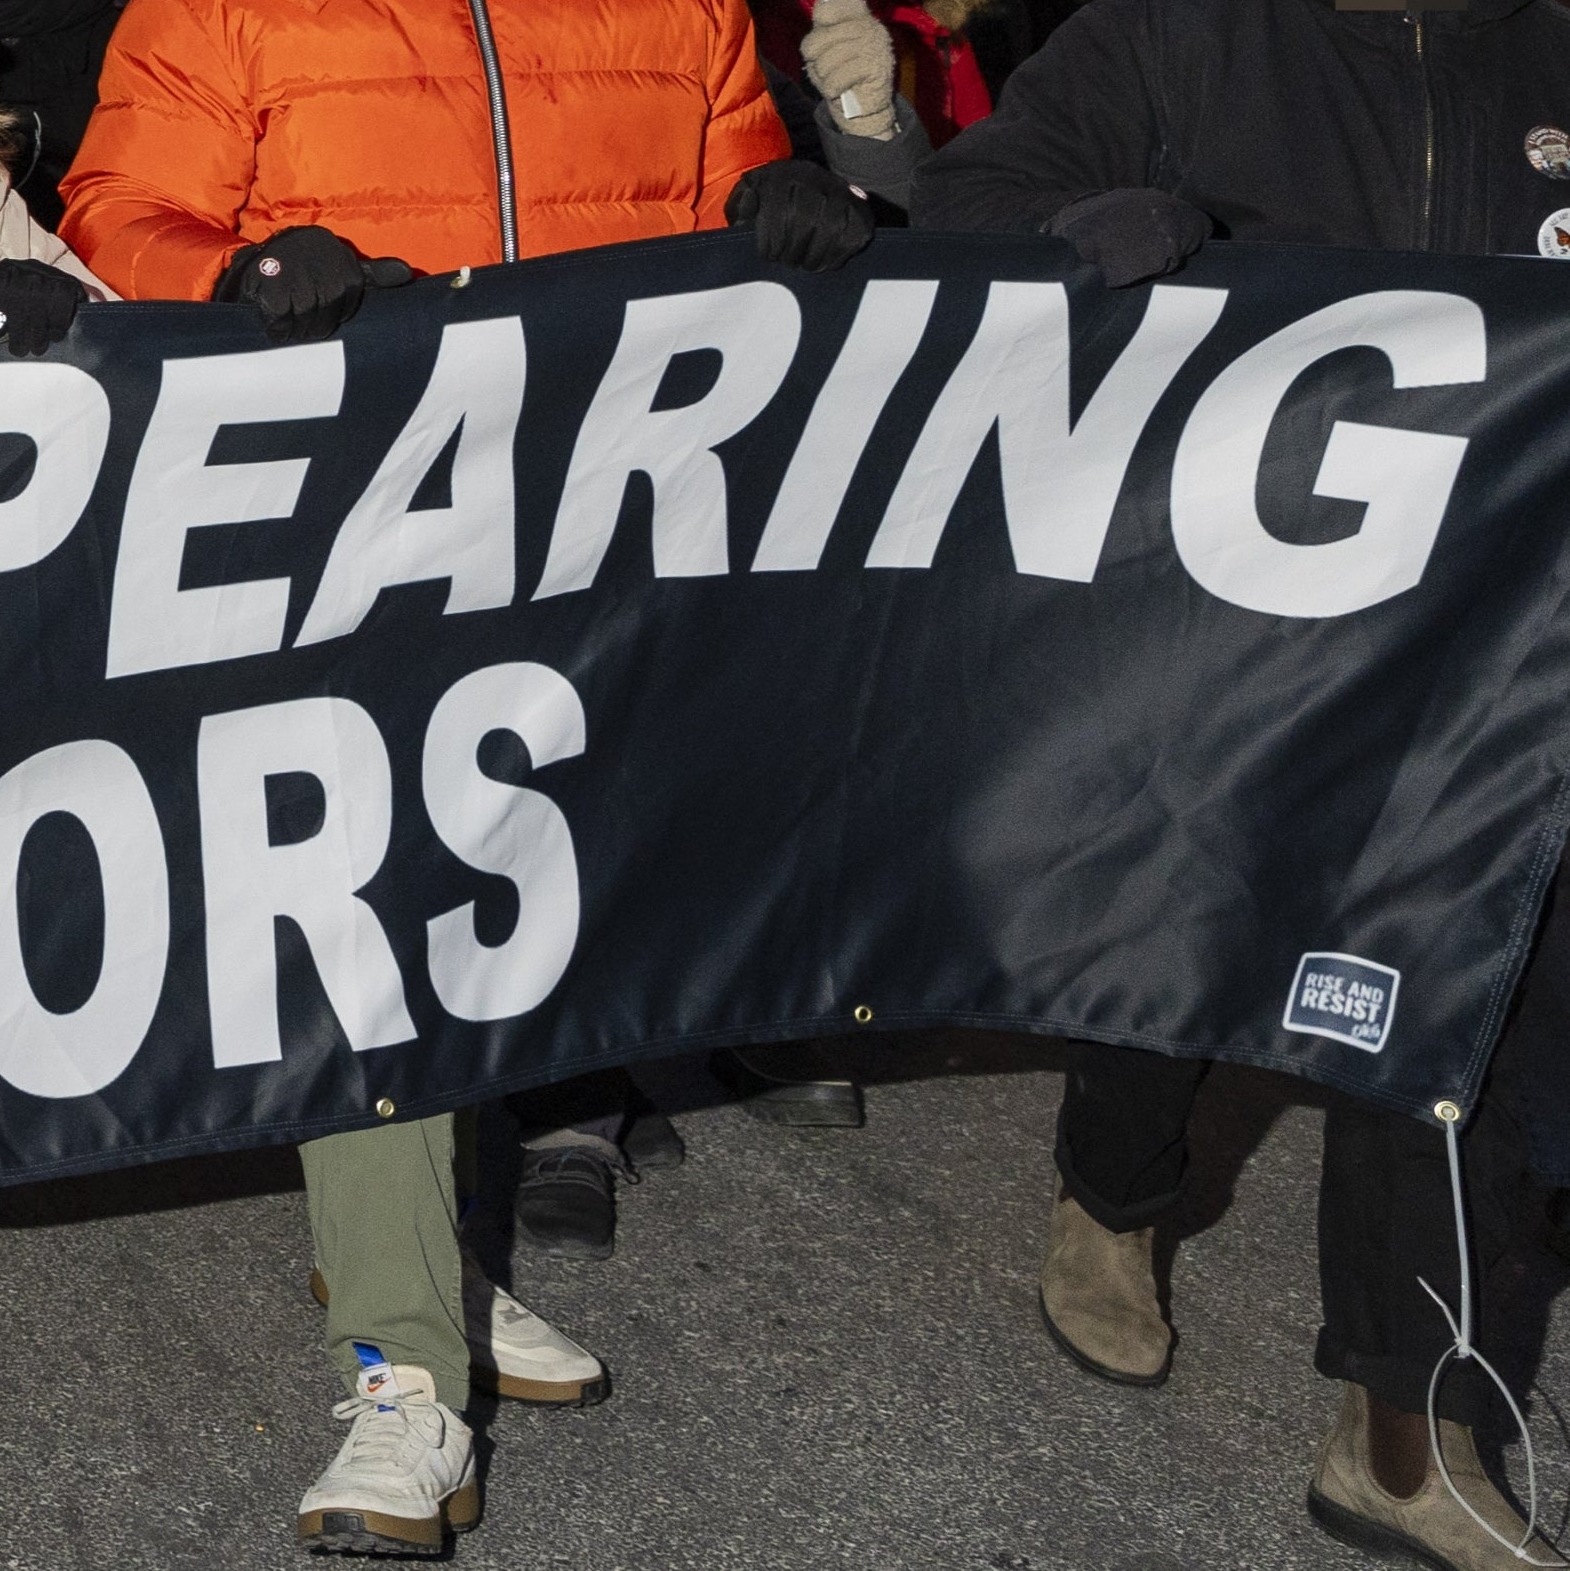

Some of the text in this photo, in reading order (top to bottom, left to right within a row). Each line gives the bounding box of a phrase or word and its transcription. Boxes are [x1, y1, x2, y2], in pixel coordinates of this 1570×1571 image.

[1305, 972, 1385, 1004] RISE AND
[1301, 988, 1381, 1024] RESIST
